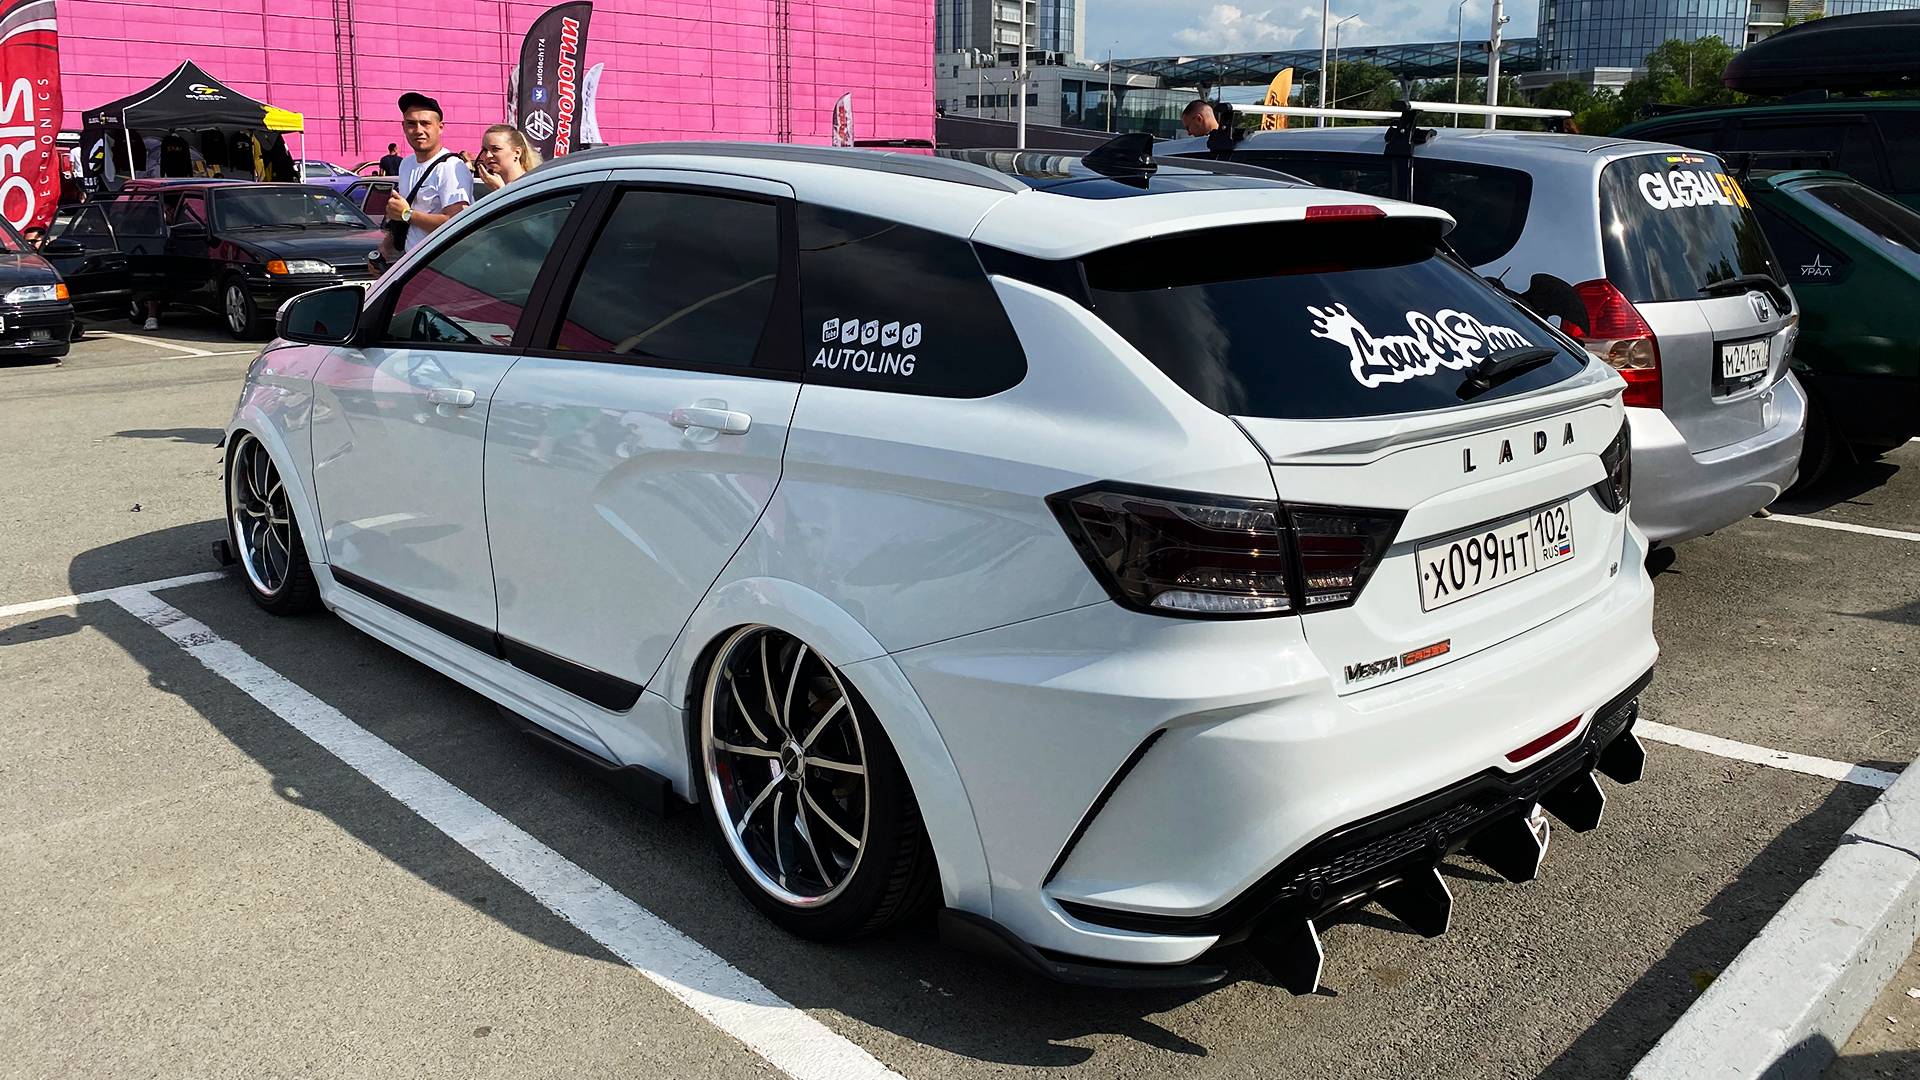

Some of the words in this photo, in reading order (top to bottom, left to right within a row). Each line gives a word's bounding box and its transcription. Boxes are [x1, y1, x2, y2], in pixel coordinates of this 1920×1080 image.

[1800, 267, 1831, 277] УРАЛ
[812, 347, 917, 377] AUTOLING
[1463, 422, 1575, 474] LADA
[1534, 506, 1567, 547] 102
[1542, 545, 1560, 562] RUS
[1343, 655, 1399, 685] VESTA
